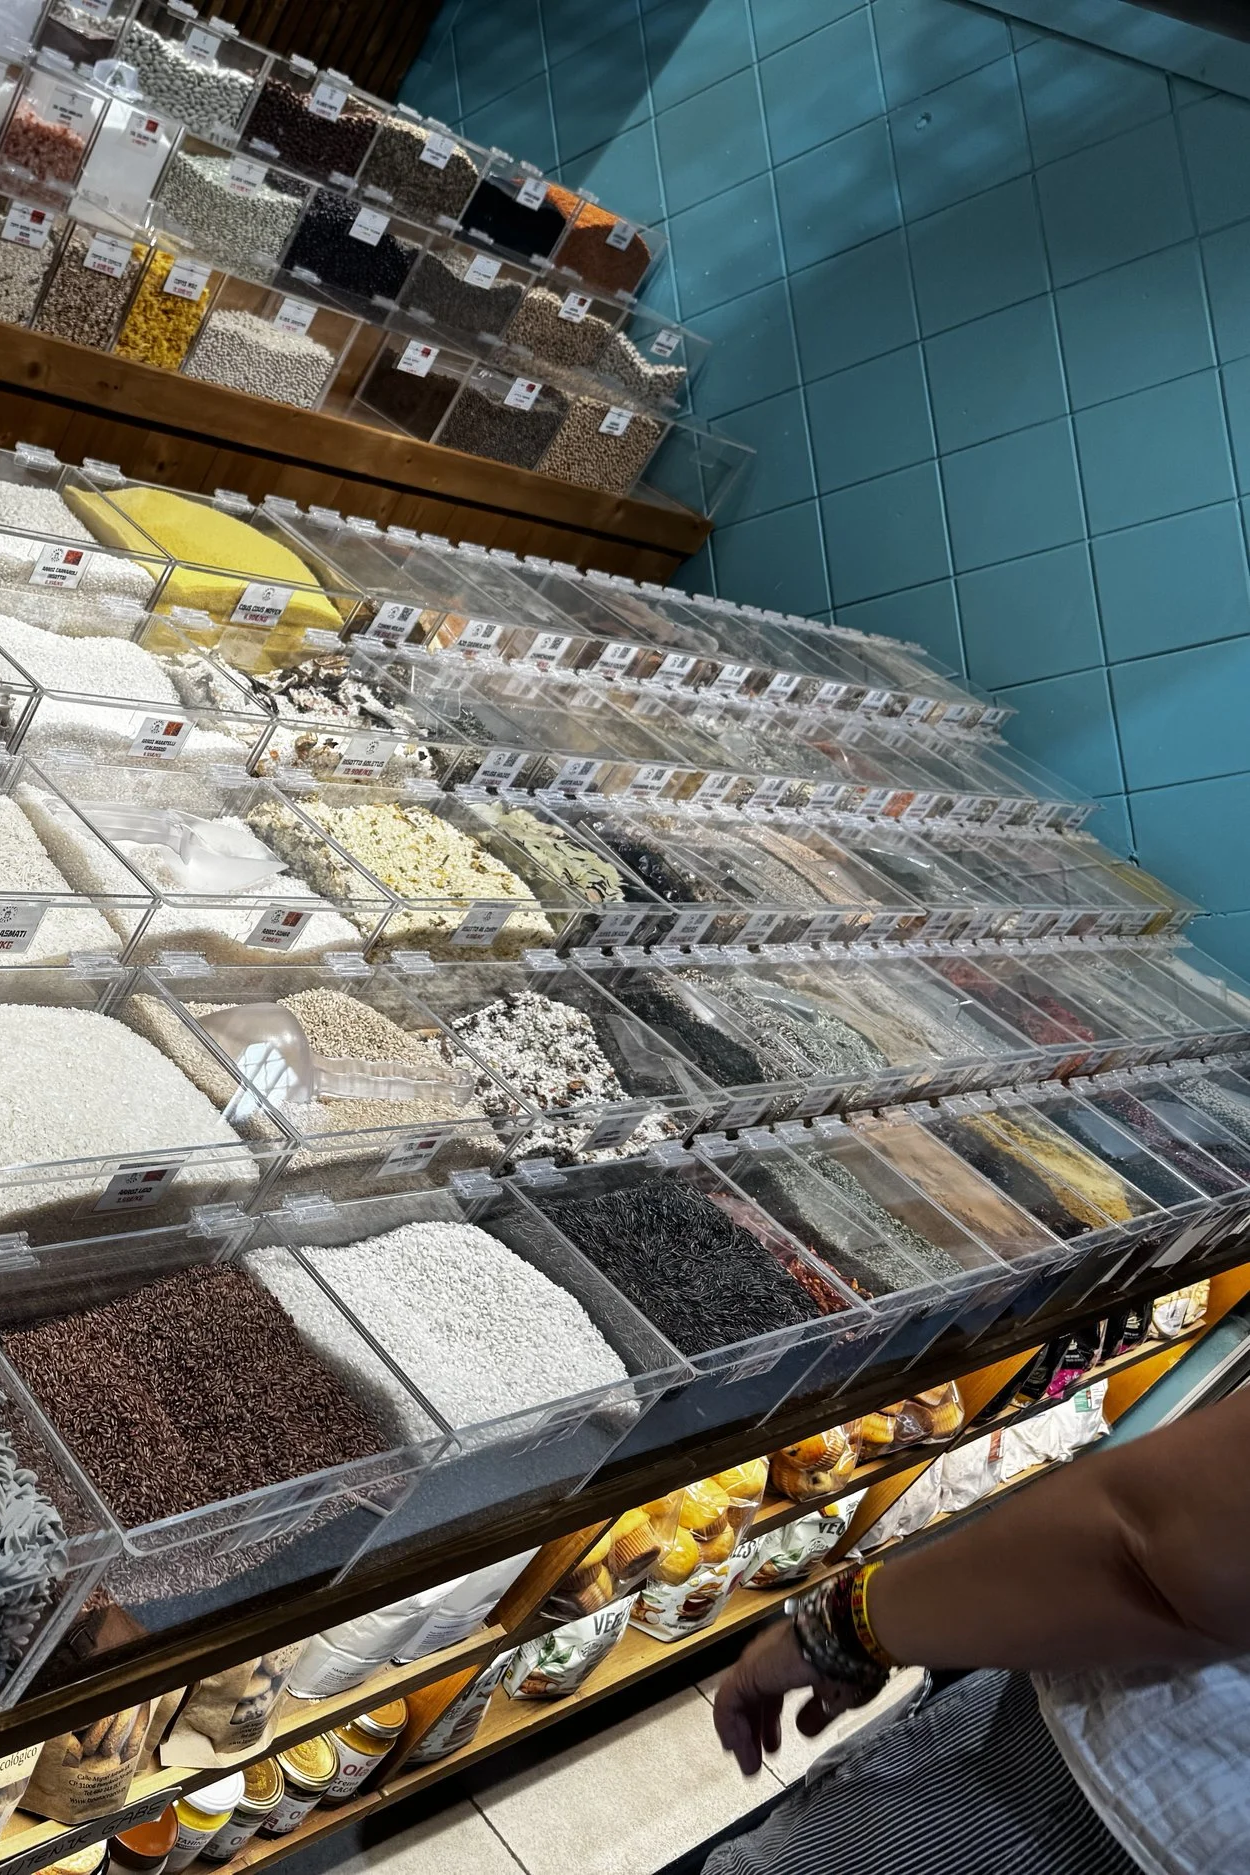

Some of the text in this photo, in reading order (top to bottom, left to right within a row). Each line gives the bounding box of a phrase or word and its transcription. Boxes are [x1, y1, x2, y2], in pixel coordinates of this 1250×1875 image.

[238, 603, 253, 612] COUS
[251, 605, 266, 614] COUS
[341, 759, 362, 768] RISOTTO
[101, 1799, 167, 1835] GABE
